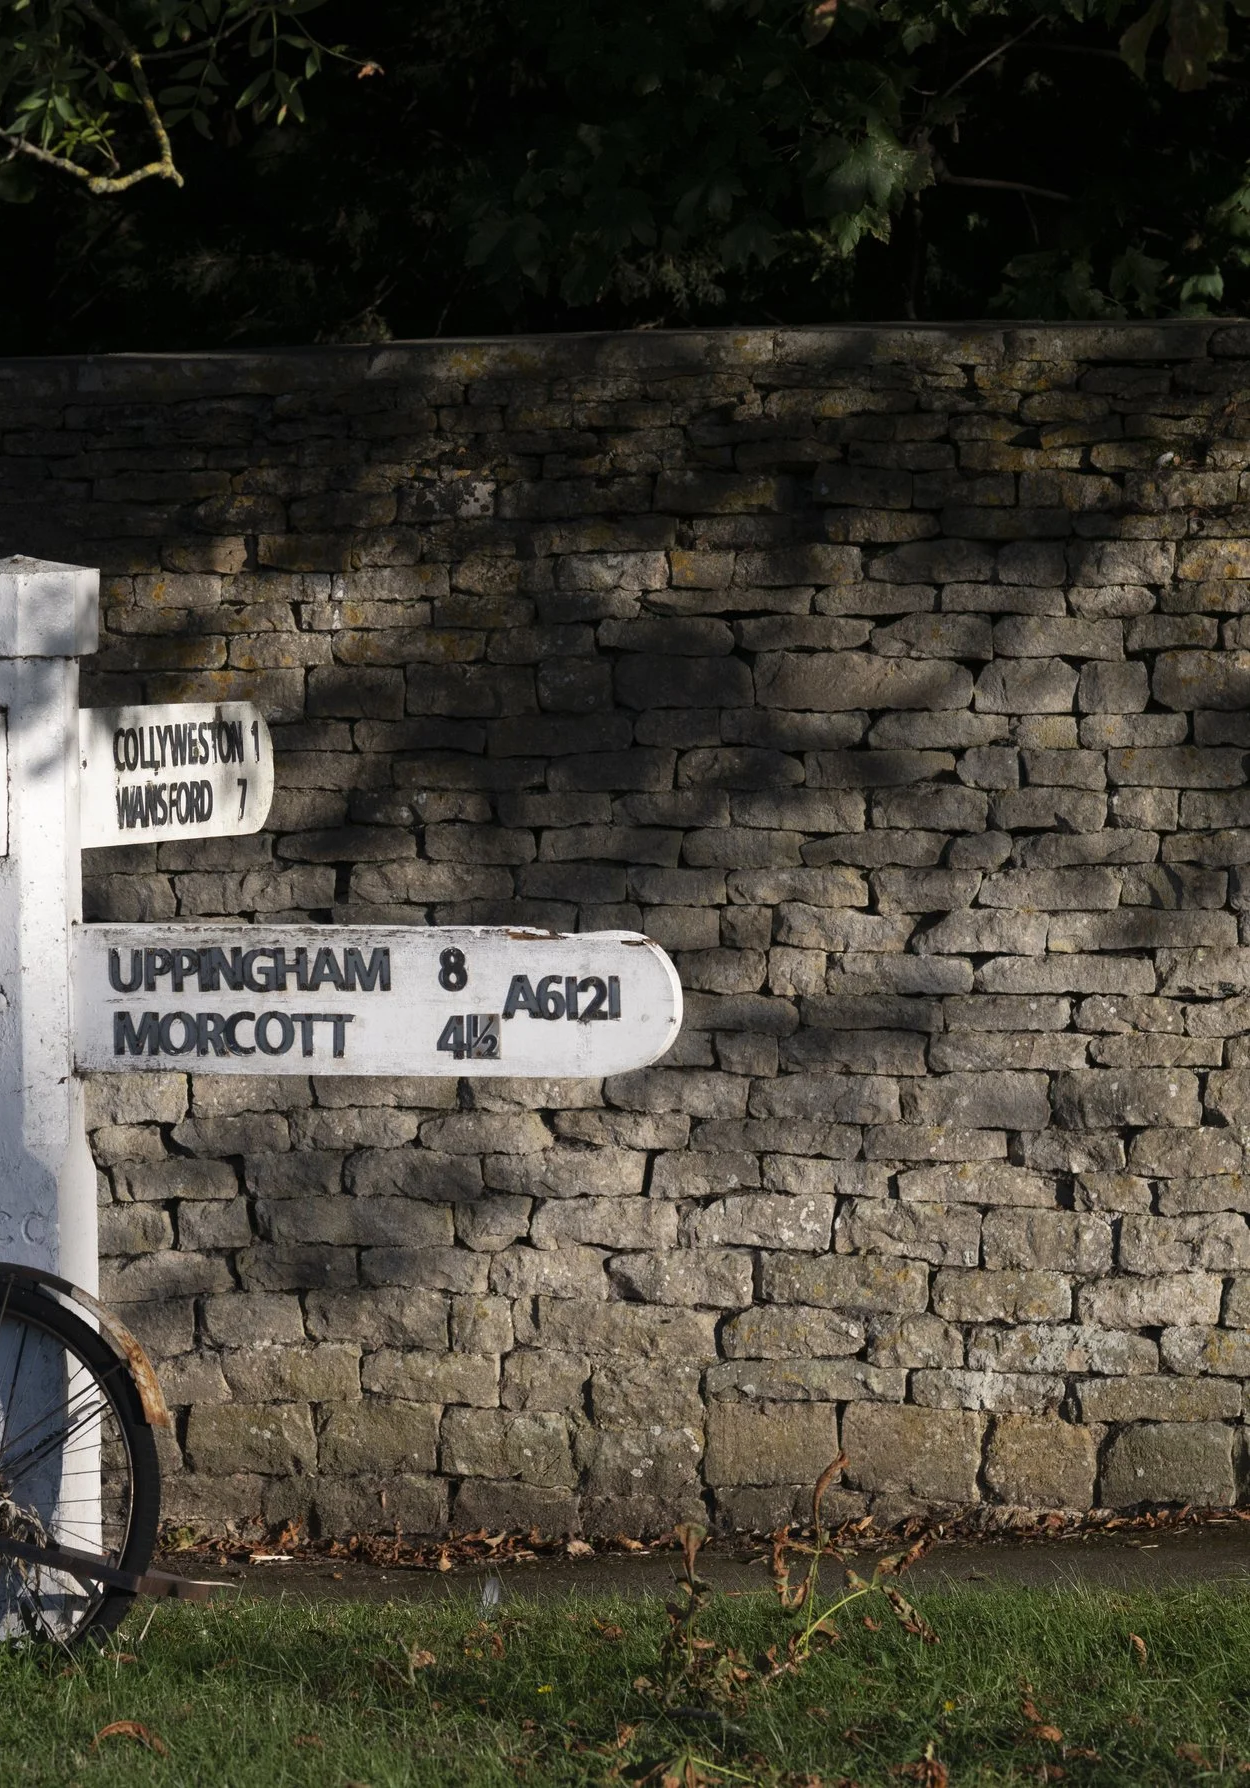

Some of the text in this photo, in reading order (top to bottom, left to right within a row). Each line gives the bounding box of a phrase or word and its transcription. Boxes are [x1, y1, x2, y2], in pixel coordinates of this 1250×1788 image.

[113, 721, 260, 771] COLLYWESTON 1
[116, 778, 248, 829] WANSFORD 7
[108, 946, 468, 993] UPPINGHAM 8
[502, 974, 622, 1021] A6121
[113, 1011, 501, 1060] MORCOTT 4½
